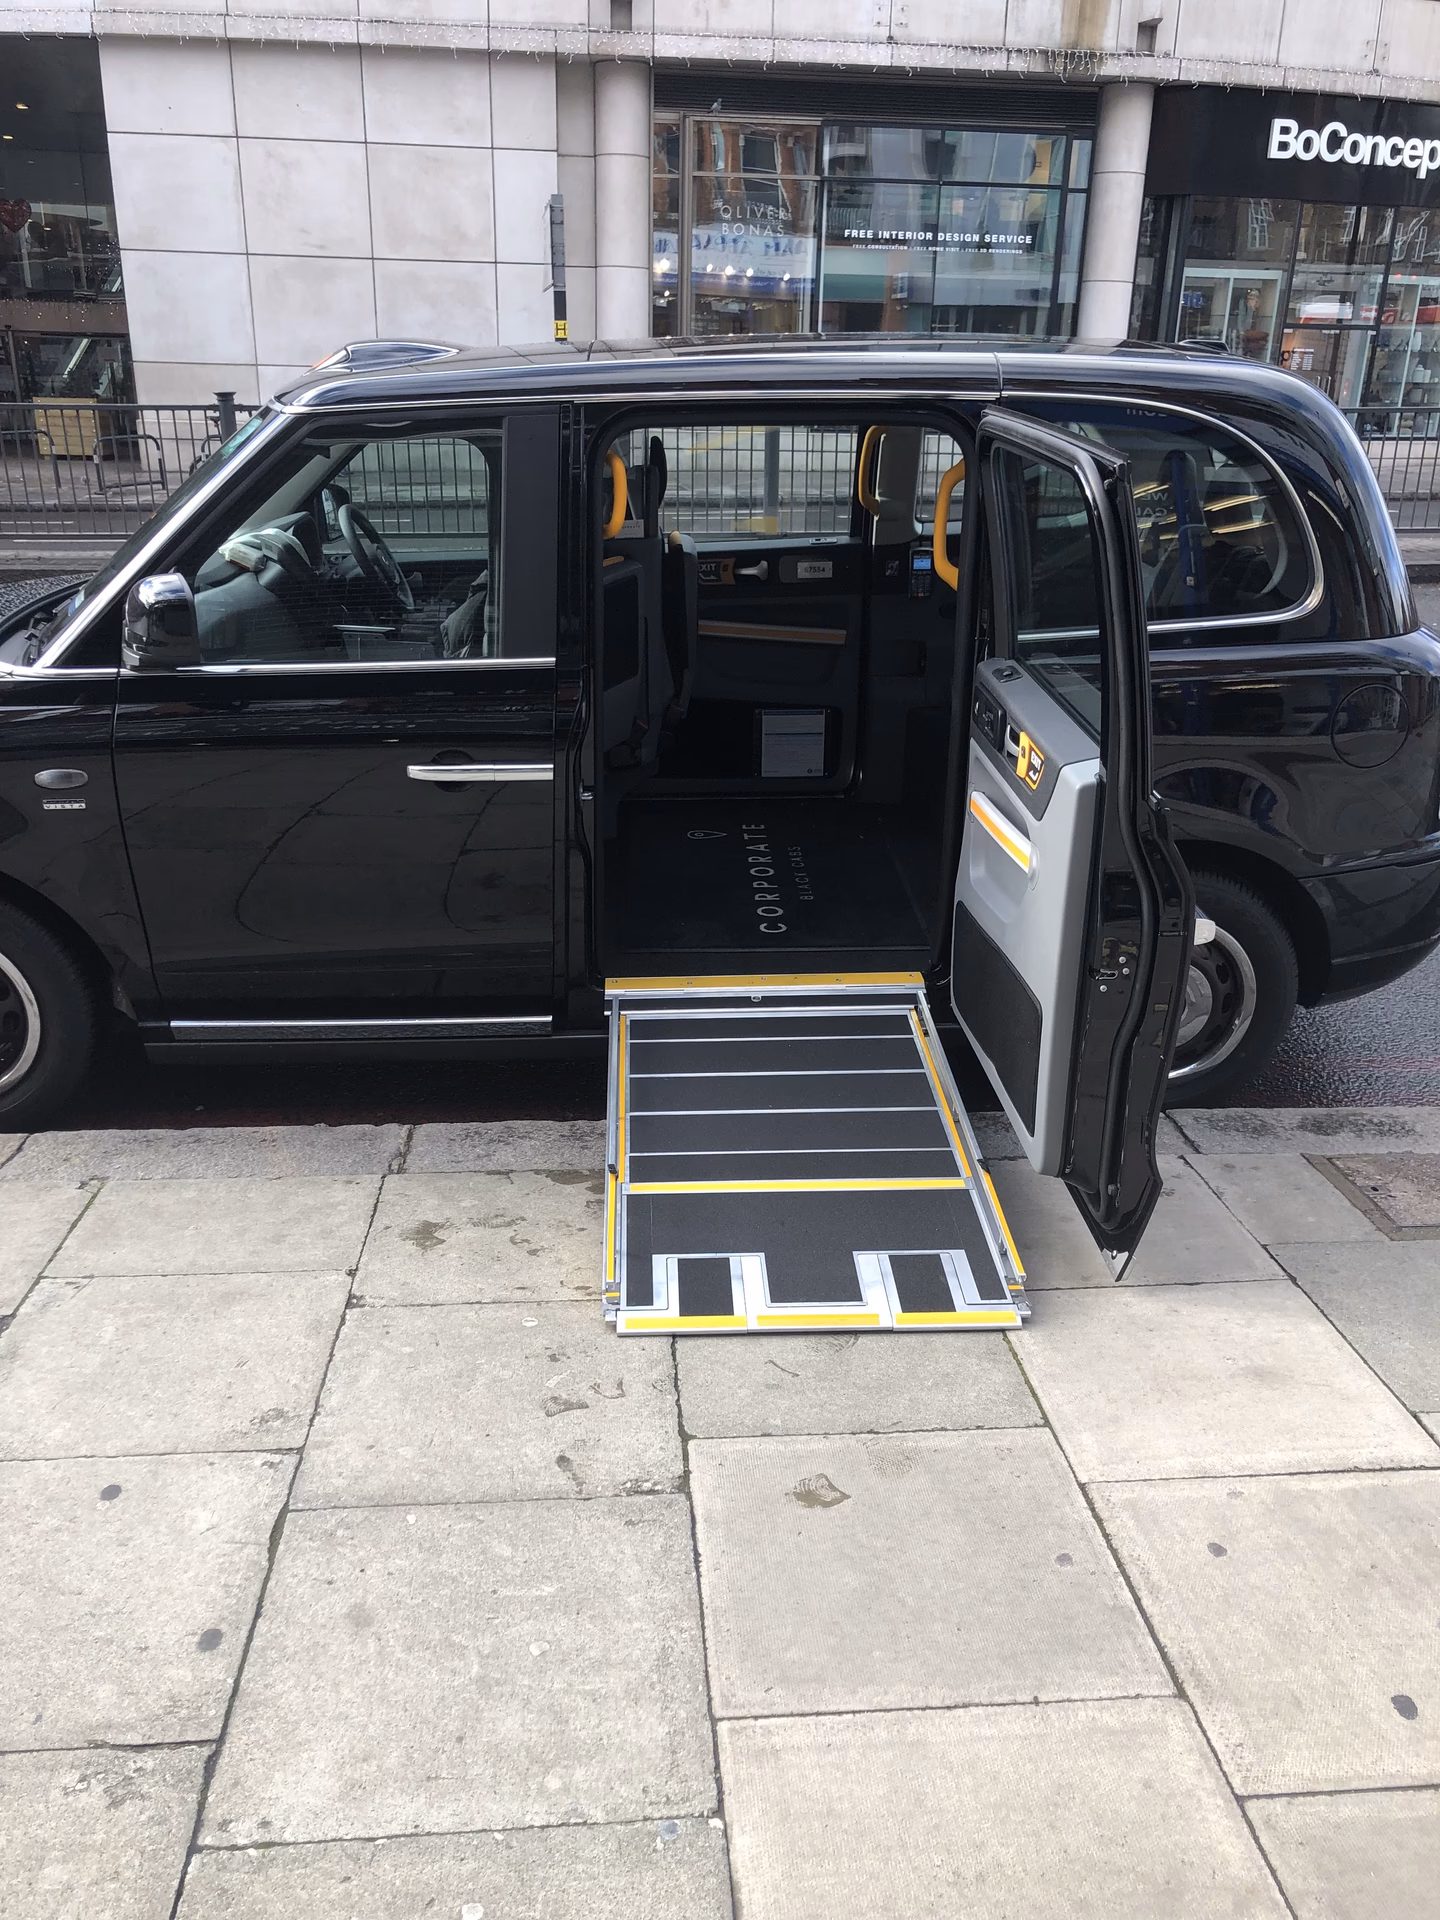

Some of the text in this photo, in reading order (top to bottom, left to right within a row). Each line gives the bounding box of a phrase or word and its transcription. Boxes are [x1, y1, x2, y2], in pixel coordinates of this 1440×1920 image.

[722, 223, 785, 237] BONAS
[844, 229, 1033, 244] FREE INTERIOR DESIGN SERVICE
[555, 322, 567, 336] H
[787, 846, 805, 867] CABS
[742, 824, 787, 933] CORPORATE
